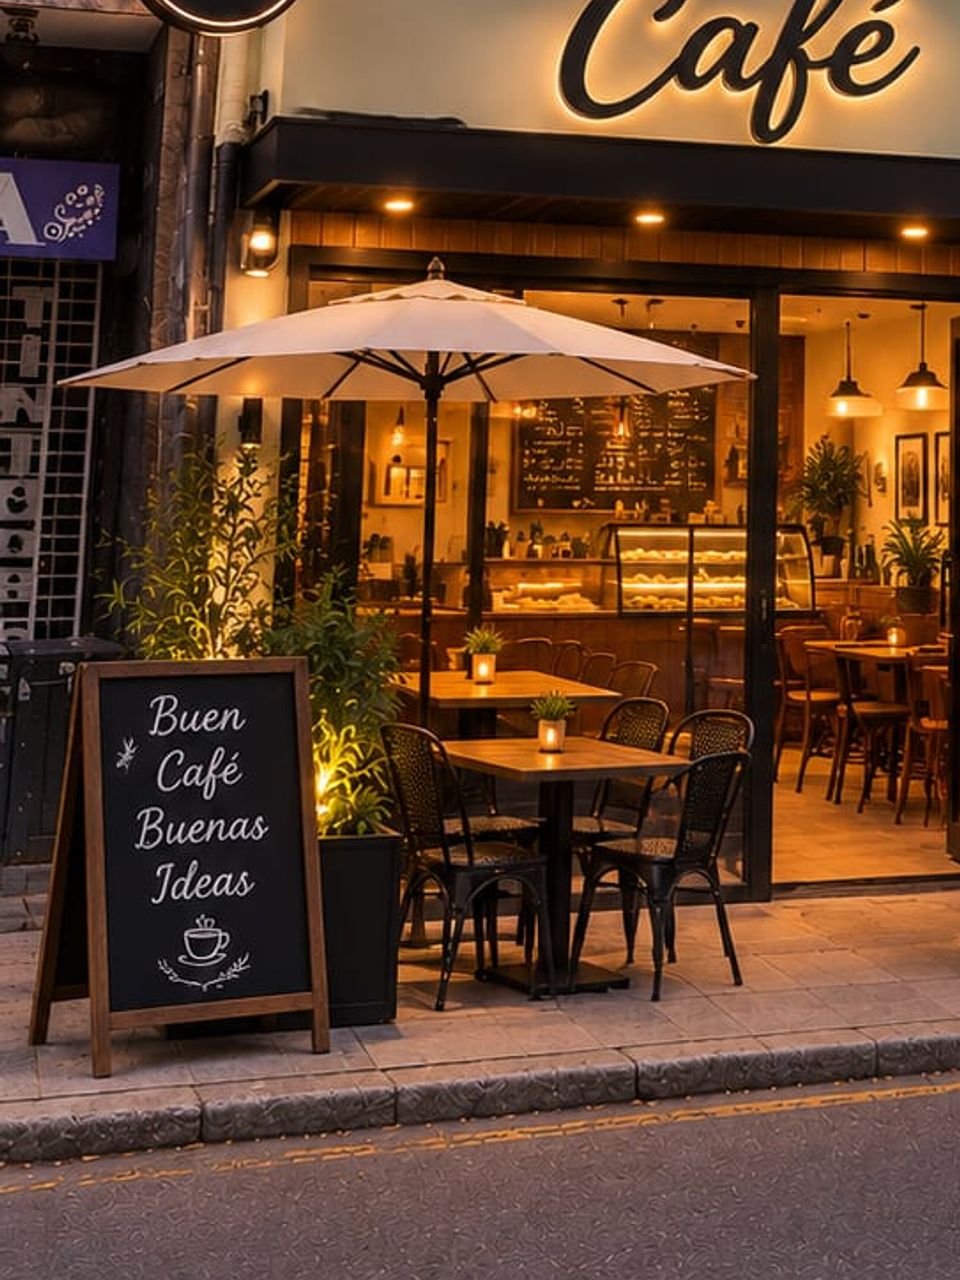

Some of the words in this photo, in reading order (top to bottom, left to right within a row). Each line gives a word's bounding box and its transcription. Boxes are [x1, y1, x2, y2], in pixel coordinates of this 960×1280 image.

[149, 694, 246, 737] Buen
[156, 746, 243, 800] Café
[134, 806, 269, 850] Buenas
[151, 859, 255, 904] Ideas
